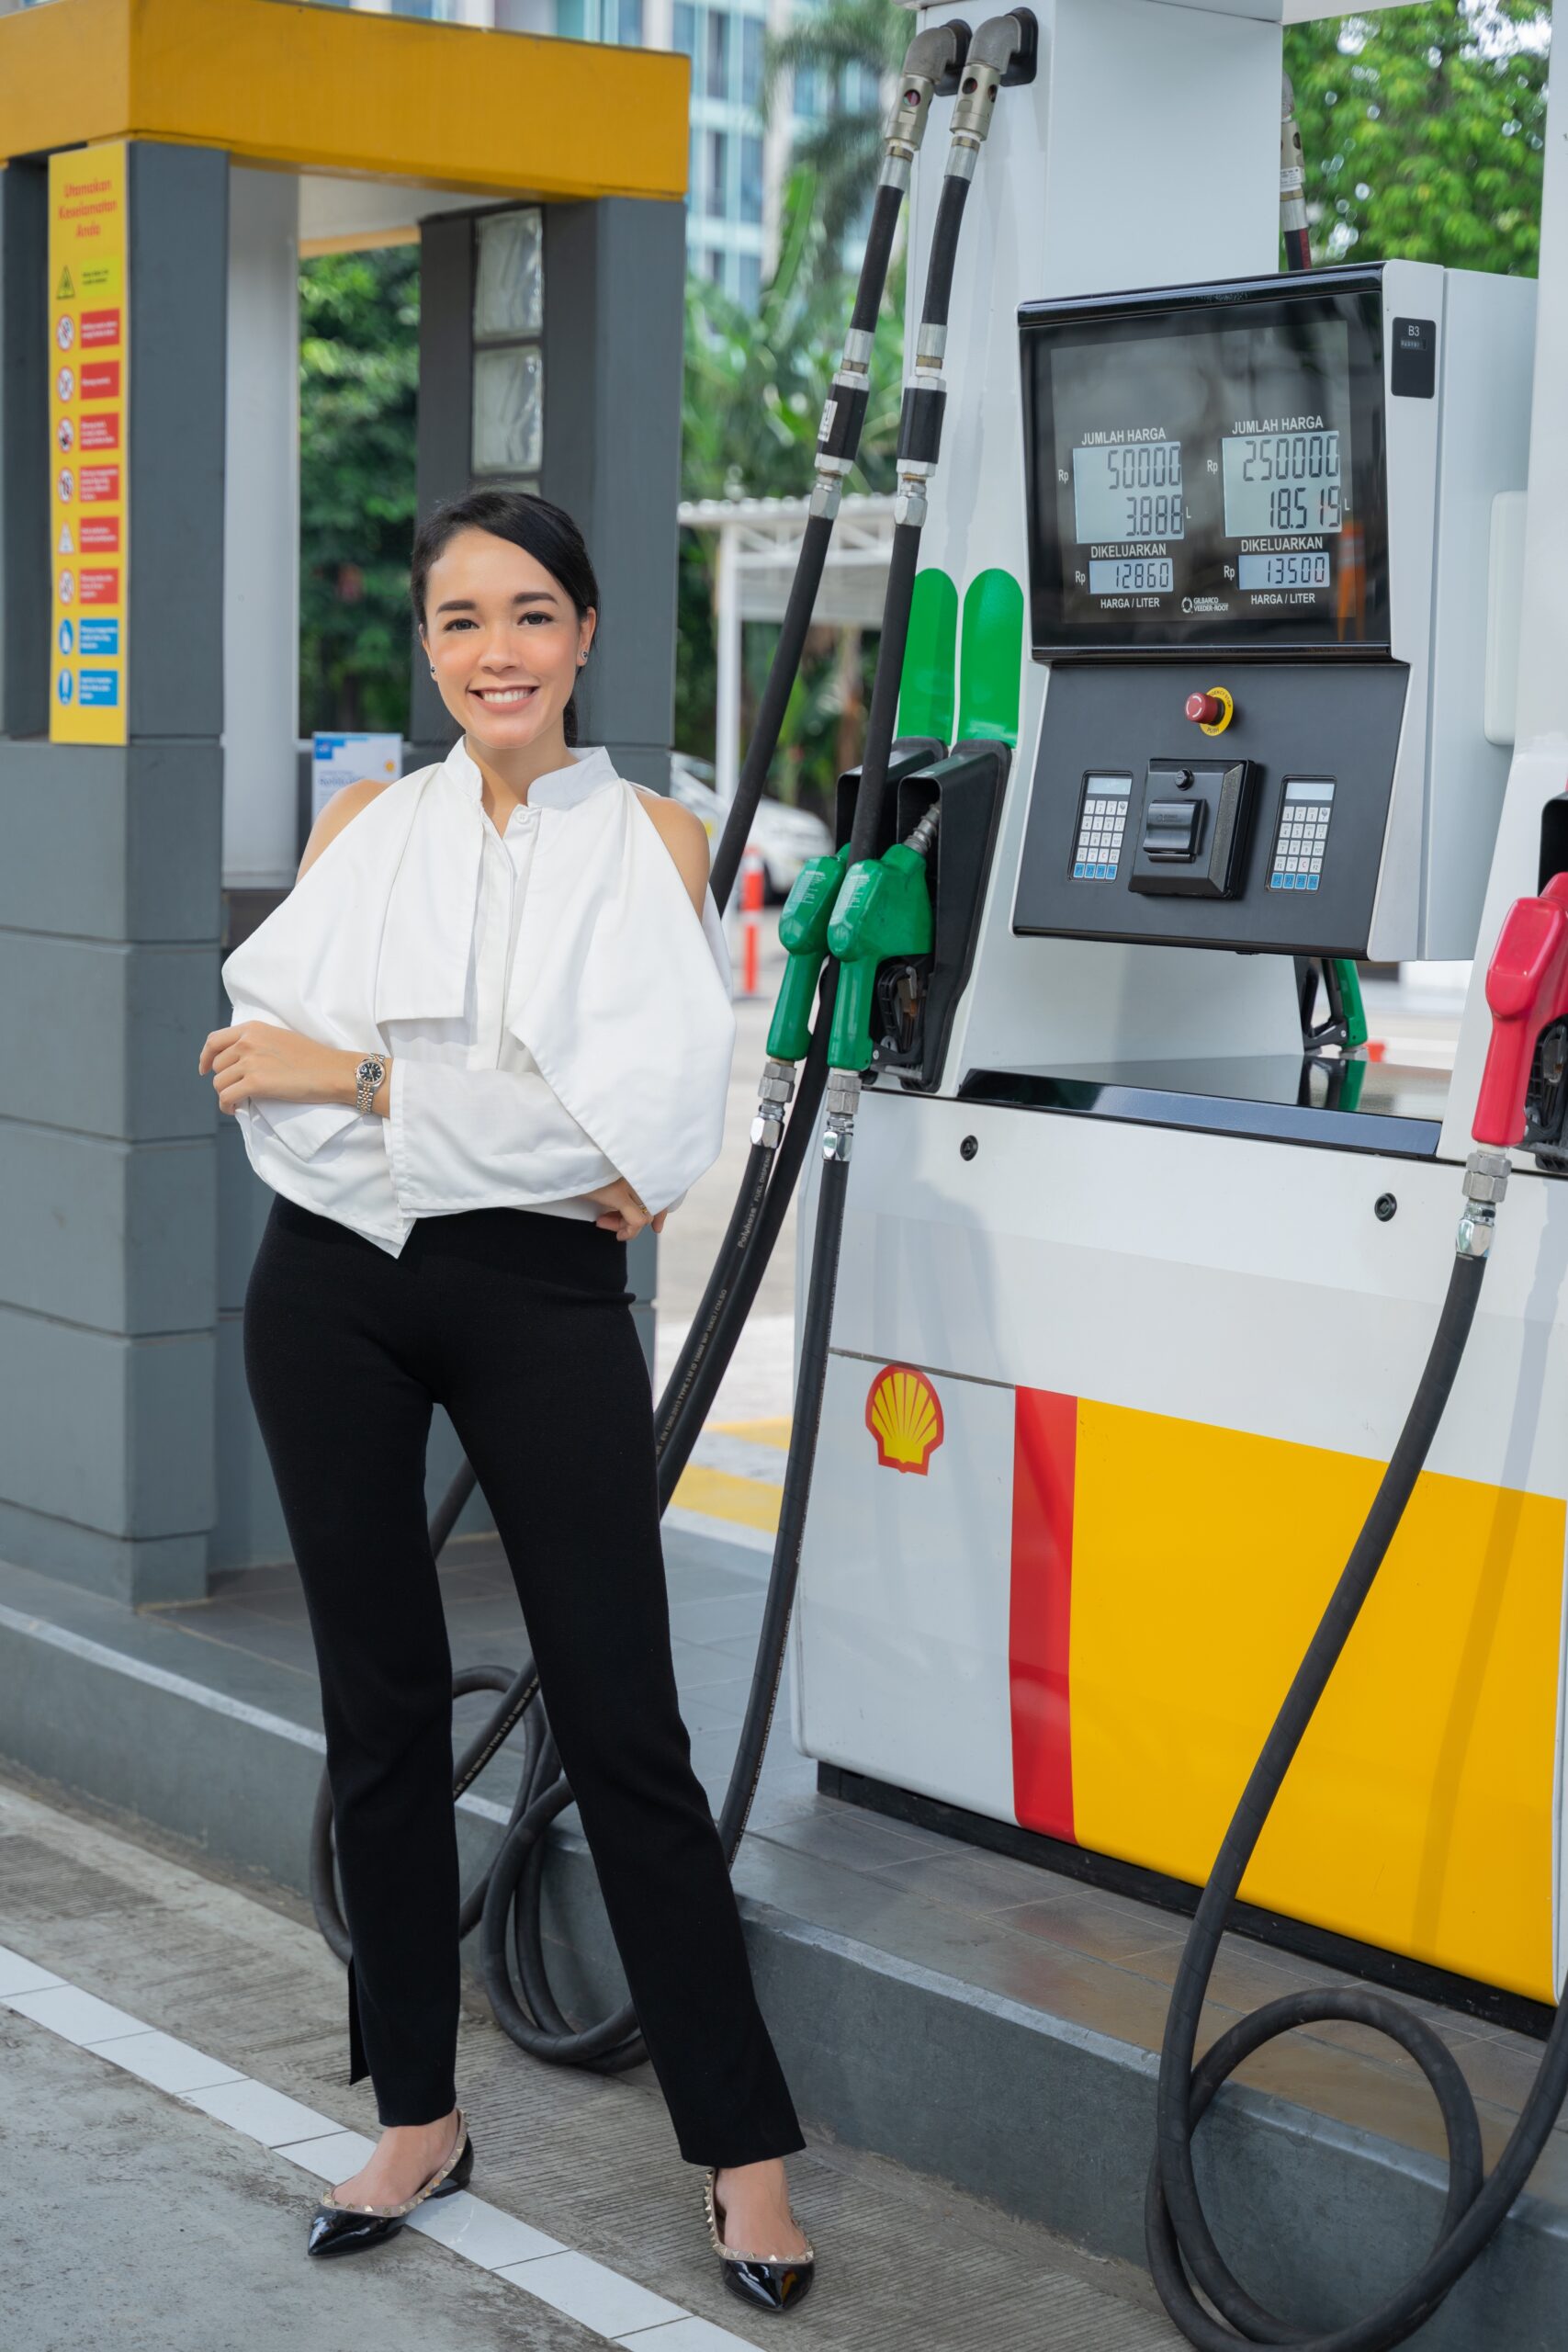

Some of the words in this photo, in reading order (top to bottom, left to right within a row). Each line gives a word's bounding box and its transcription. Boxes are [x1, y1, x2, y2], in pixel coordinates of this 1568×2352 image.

[1408, 325, 1419, 337] B3
[1082, 430, 1123, 446] JUMLAH
[1128, 427, 1166, 441] HARGA
[1232, 418, 1279, 435] JUMLAH
[1282, 415, 1324, 430] HARGA
[1058, 469, 1069, 483] Rp
[1108, 447, 1182, 490] 50000
[1207, 460, 1218, 474] Rp
[1243, 435, 1338, 481] 250000
[1126, 494, 1183, 537] 3.888
[1186, 506, 1190, 518] L
[1270, 486, 1340, 529] 18.519
[1345, 498, 1349, 511] L
[1091, 544, 1166, 559] DIKELUARKAN
[1241, 537, 1323, 552] DIKELUARKAN
[1076, 571, 1086, 585] Rp
[1116, 562, 1169, 588] 12860
[1224, 565, 1235, 580] Rp
[1268, 557, 1325, 583] 13500
[1100, 598, 1131, 608] HARGA
[1136, 598, 1160, 608] LITER
[1251, 594, 1283, 605] HARGA
[1290, 593, 1315, 604] LITER
[736, 1205, 757, 1248] Polyhose
[753, 1182, 763, 1202] FUEL
